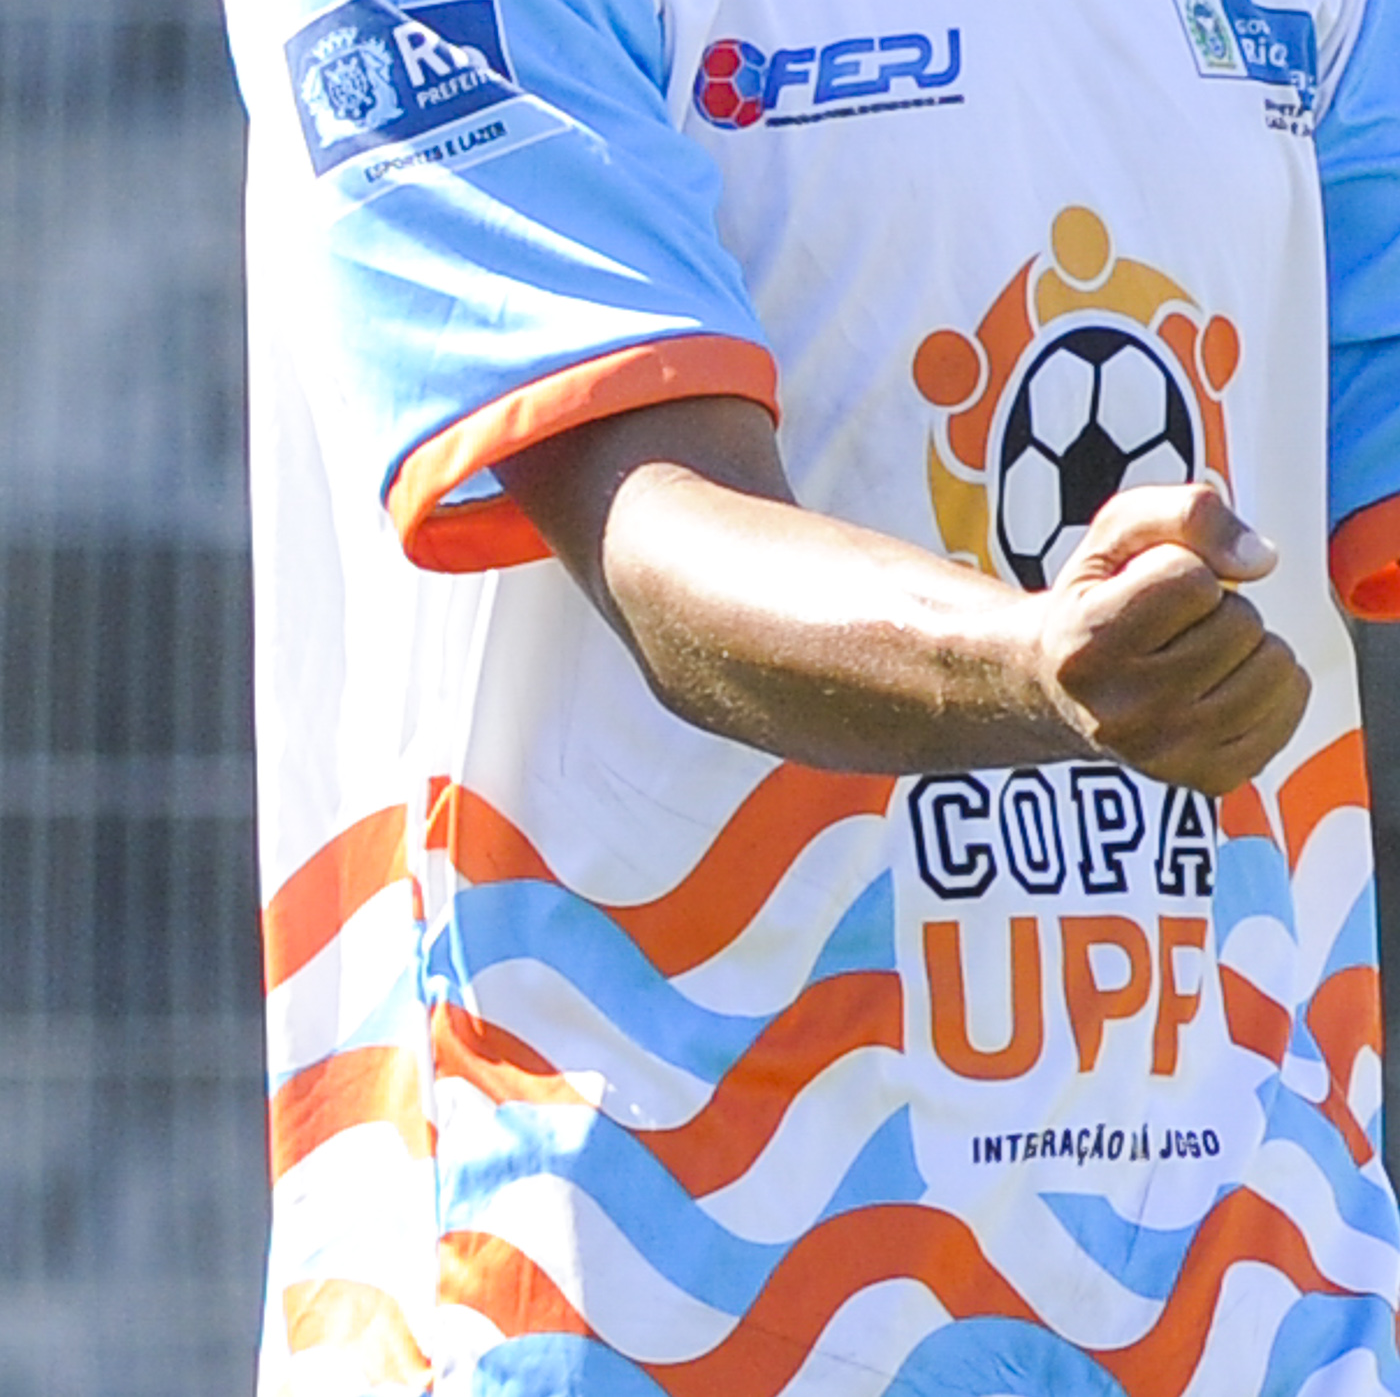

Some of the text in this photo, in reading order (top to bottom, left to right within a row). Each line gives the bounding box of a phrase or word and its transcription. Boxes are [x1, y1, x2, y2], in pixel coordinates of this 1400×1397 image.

[763, 27, 961, 110] FERJ
[908, 765, 1218, 899] COPA
[921, 913, 1208, 1082] UPP
[972, 1122, 1125, 1167] INTERAÇÃO
